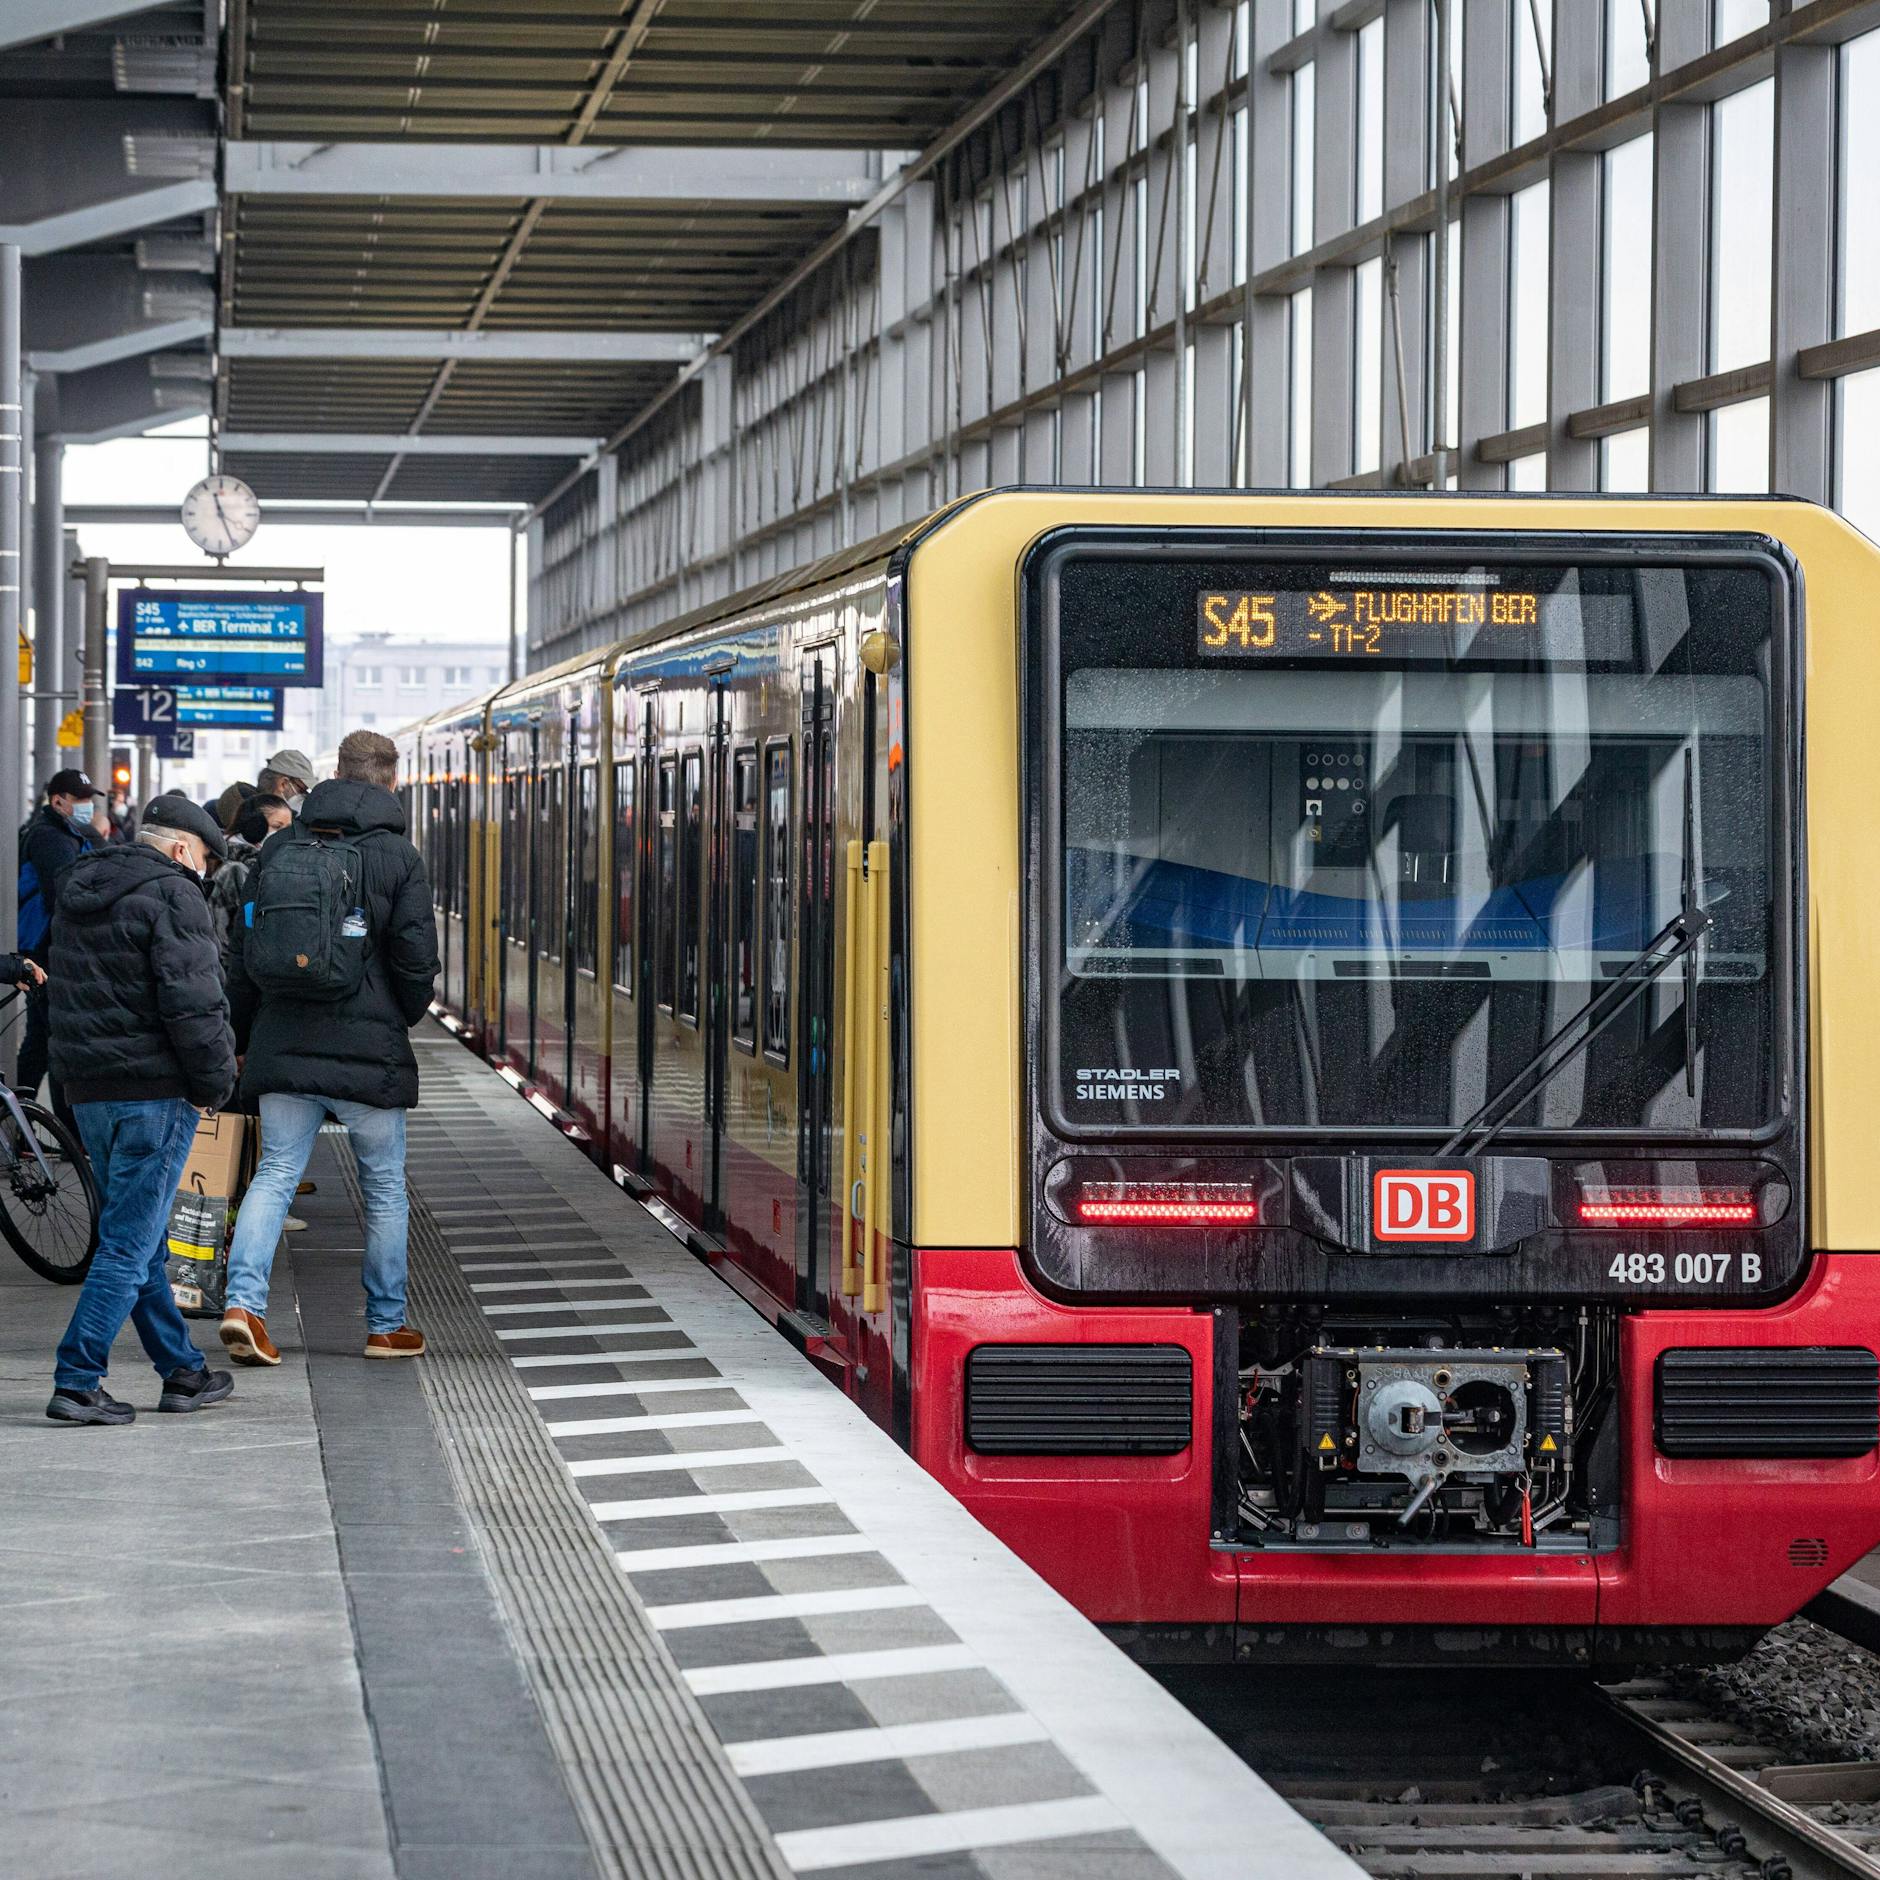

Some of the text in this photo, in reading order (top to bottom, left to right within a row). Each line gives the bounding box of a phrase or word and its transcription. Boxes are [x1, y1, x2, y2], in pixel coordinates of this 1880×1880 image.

[136, 602, 161, 616] S45
[1355, 592, 1536, 624] FLUGHAFEN BER
[192, 620, 298, 635] BER Terminal 1-2
[1204, 596, 1275, 647] S45
[1330, 624, 1381, 653] T1-2
[135, 657, 154, 668] S42
[136, 690, 173, 722] 12
[170, 733, 193, 752] 12
[1076, 1068, 1181, 1081] STADLER
[1076, 1084, 1165, 1100] SIEMENS
[1387, 1182, 1462, 1229] DB
[1608, 1253, 1762, 1284] 483 007 B
